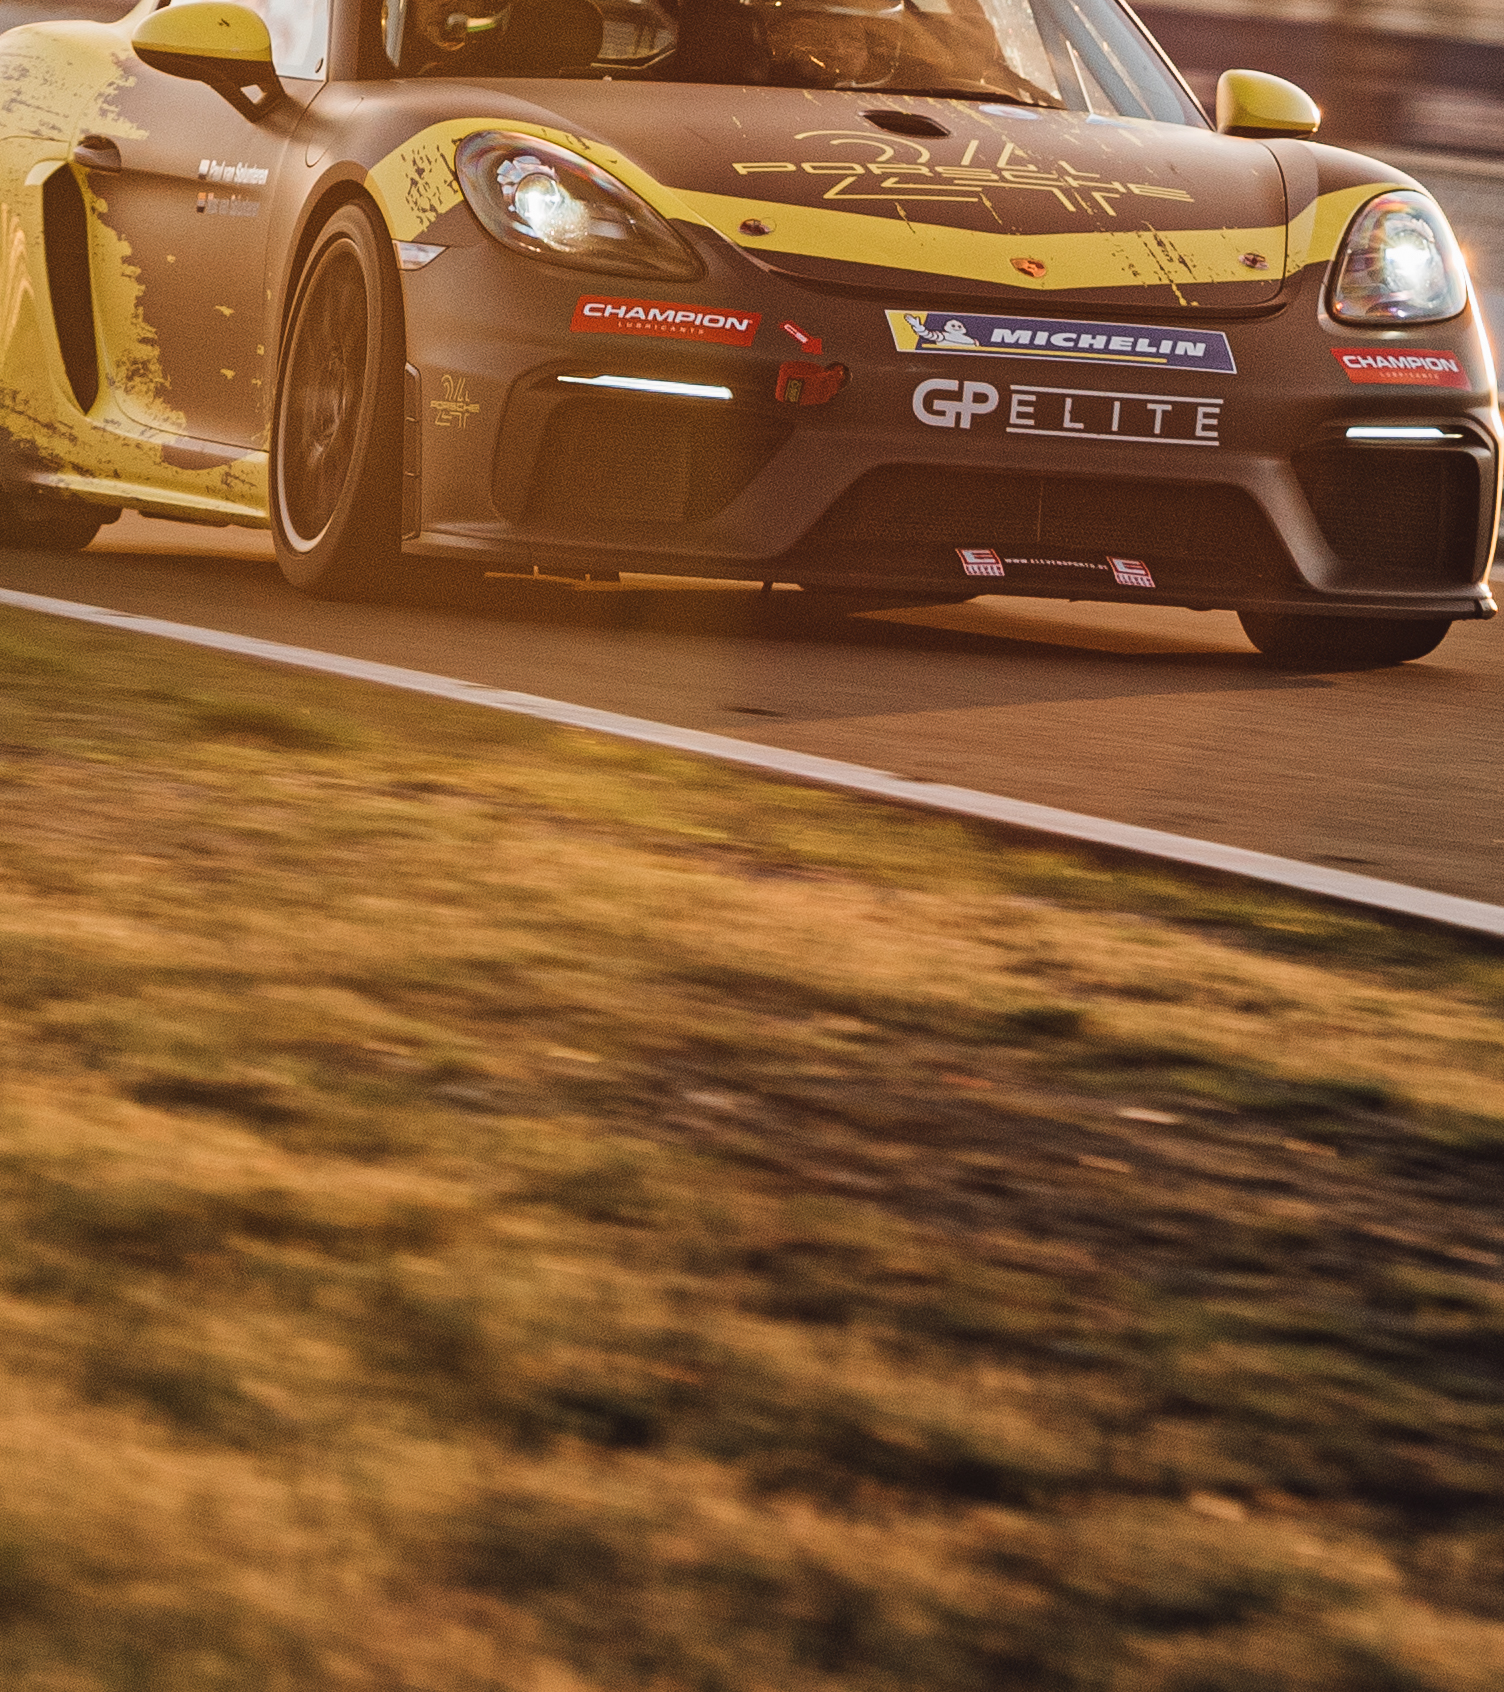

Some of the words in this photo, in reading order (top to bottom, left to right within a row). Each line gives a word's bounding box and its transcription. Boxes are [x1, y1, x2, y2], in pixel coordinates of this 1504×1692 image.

[732, 161, 1195, 203] PORSCHE
[583, 302, 748, 331] CHAMPION
[990, 327, 1207, 357] MICHELIN
[1342, 355, 1459, 373] CHAMPION
[1009, 393, 1221, 438] ELITE
